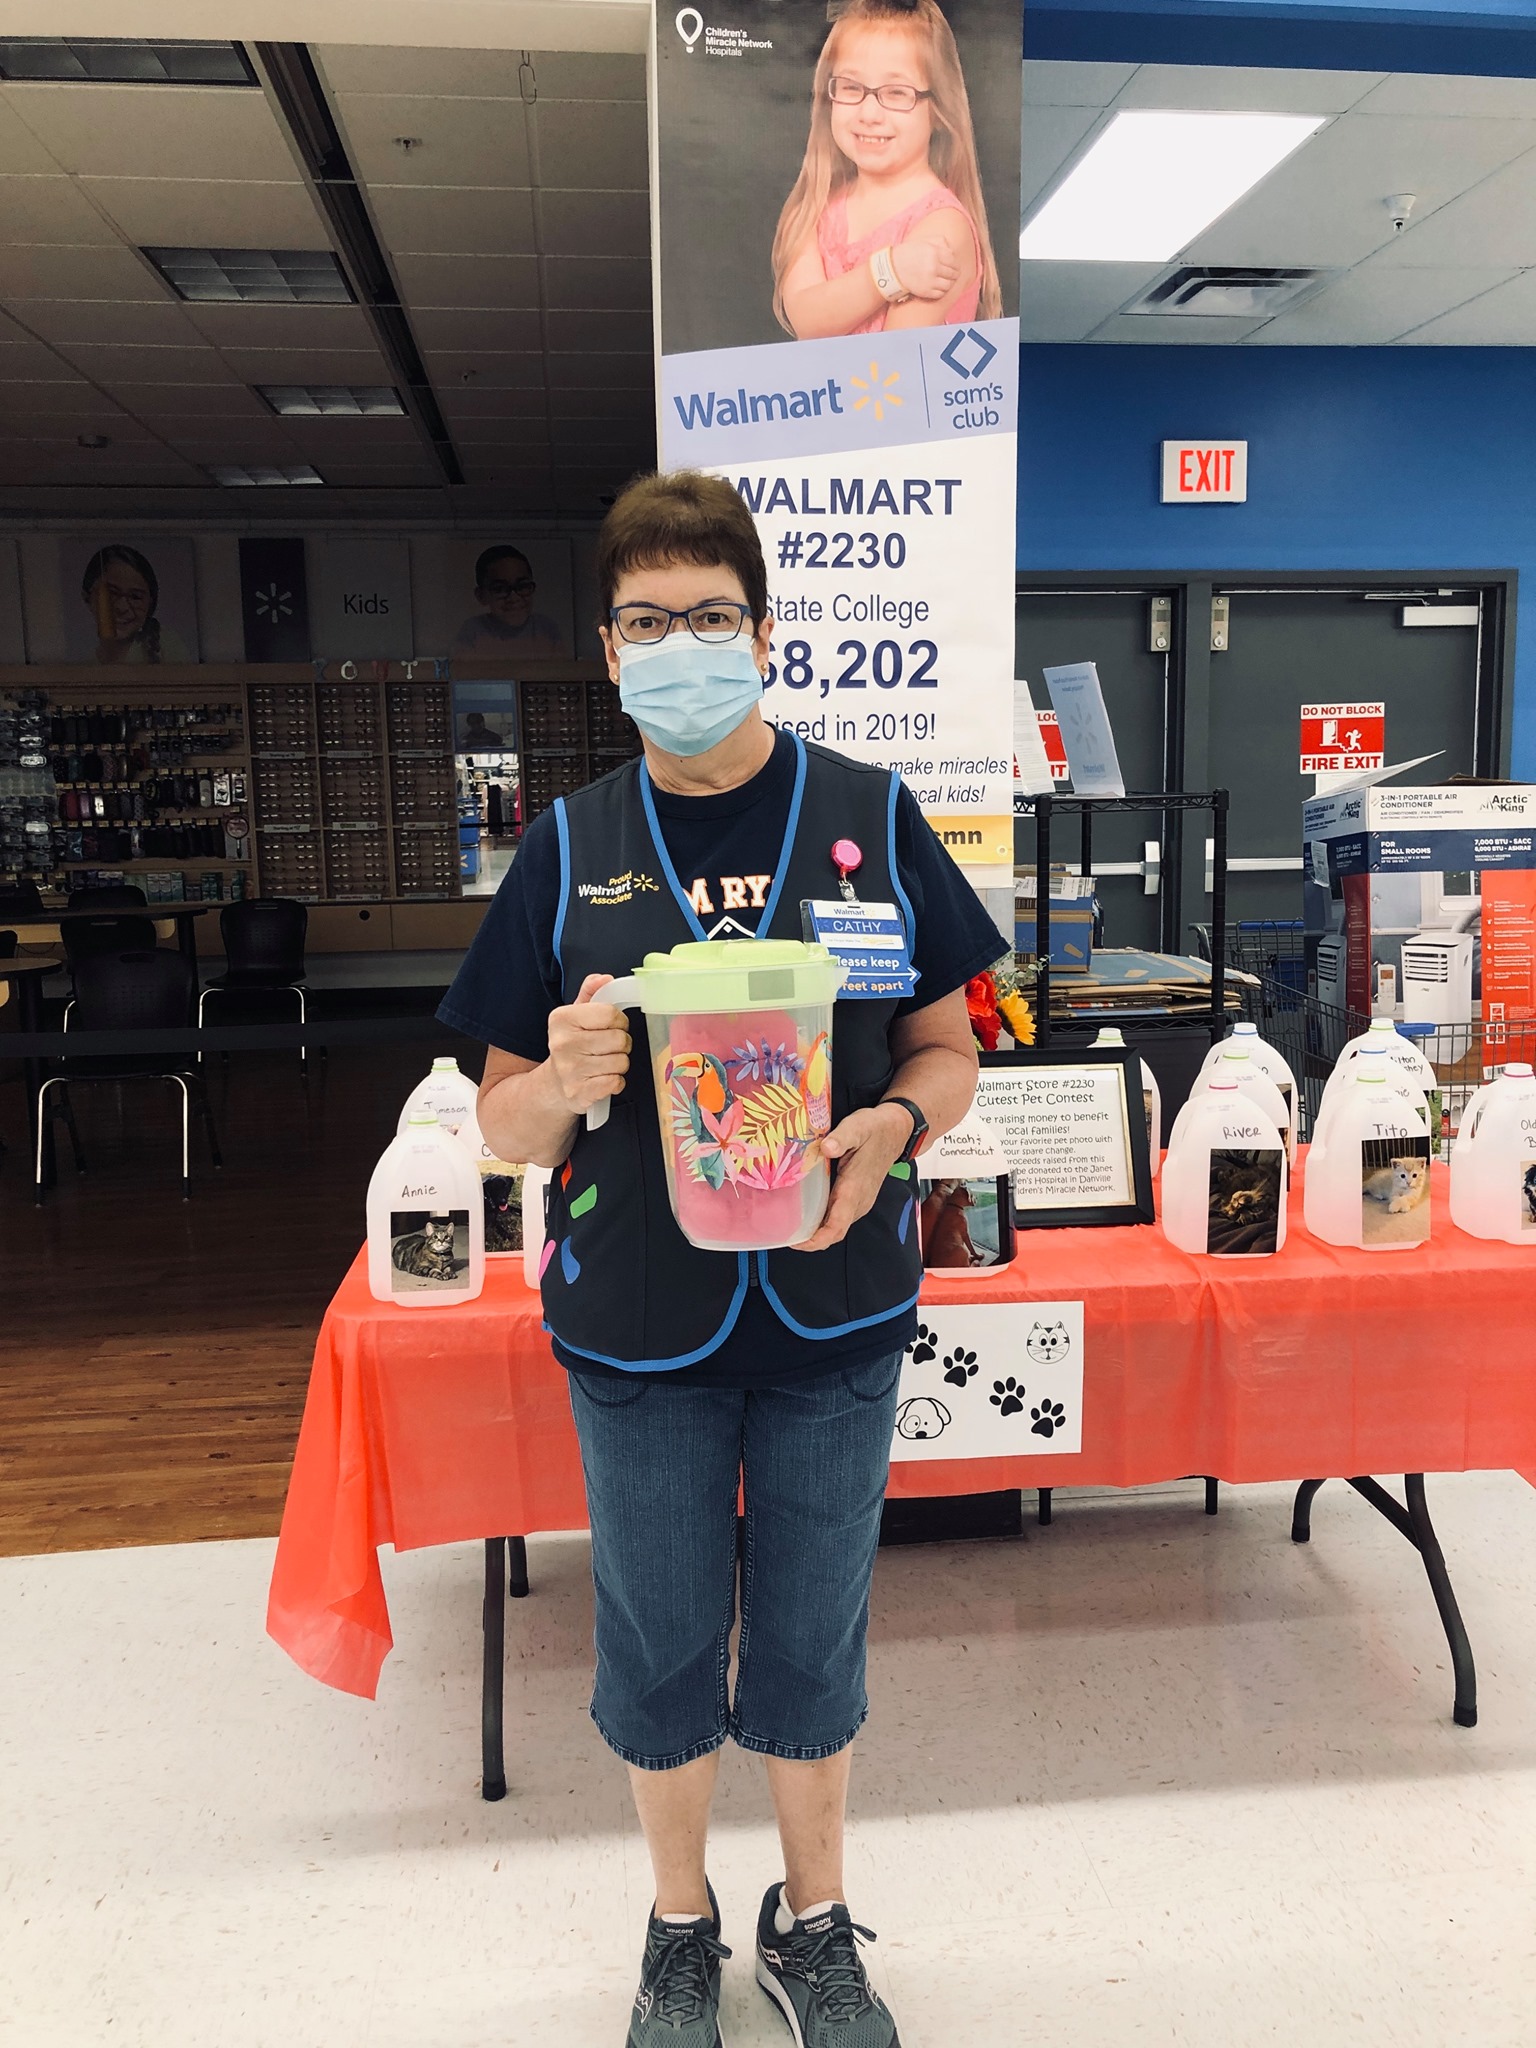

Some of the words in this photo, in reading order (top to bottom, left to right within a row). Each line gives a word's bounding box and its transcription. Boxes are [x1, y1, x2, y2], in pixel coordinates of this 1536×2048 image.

[705, 27, 747, 38] Children's
[705, 36, 737, 47] Miracle
[738, 38, 773, 49] Network
[705, 46, 742, 57] Hospitals
[944, 383, 1004, 407] sam's
[673, 379, 844, 431] Walmart
[952, 407, 1000, 430] club
[1179, 450, 1235, 492] EXIT
[777, 530, 907, 570] #2230
[343, 593, 390, 615] Kids
[832, 593, 930, 629] College
[1035, 712, 1058, 722] LOC
[1302, 707, 1318, 716] DO
[1321, 706, 1343, 715] NOT
[1346, 705, 1382, 714] BLOCK
[773, 713, 826, 741] ised
[836, 714, 857, 741] in
[865, 713, 936, 741] 2019!
[889, 757, 933, 775] make
[938, 756, 1008, 775] miracles
[1302, 757, 1339, 771] FIRE
[1343, 756, 1381, 769] EXIT
[911, 785, 943, 803] ocal
[946, 785, 986, 803] kids!
[1492, 794, 1528, 804] Arctic
[1500, 804, 1524, 813] King
[1513, 837, 1532, 845] SACC
[608, 869, 633, 887] Proud
[578, 879, 632, 898] Walmart
[589, 892, 633, 905] Associate
[833, 908, 866, 916] Walmart
[833, 920, 881, 933] CATHY
[837, 955, 868, 967] lease
[870, 956, 900, 971] keep
[870, 981, 904, 994] apart
[976, 1080, 1023, 1093] Walmart
[1026, 1080, 1059, 1092] Store
[1062, 1080, 1095, 1089] #2230
[977, 1094, 1018, 1107] Cutest
[1021, 1094, 1043, 1106] Pet
[1046, 1093, 1094, 1105] Contest
[994, 1114, 1026, 1125] raising
[1028, 1114, 1058, 1123] money
[1060, 1113, 1071, 1121] to
[1074, 1112, 1109, 1122] benefit
[1005, 1127, 1028, 1136] local
[1031, 1126, 1070, 1135] families!
[1372, 1123, 1408, 1138] Tito
[943, 1134, 975, 1145] Micah
[1020, 1137, 1052, 1146] favorite
[1054, 1137, 1067, 1146] pet
[1069, 1136, 1094, 1146] photo
[1095, 1135, 1113, 1143] with
[940, 1146, 995, 1157] Connecticut
[1022, 1147, 1044, 1156] spare
[1045, 1146, 1076, 1155] change.
[1090, 1155, 1105, 1163] this
[1016, 1167, 1026, 1175] be
[1028, 1166, 1062, 1175] donated
[1063, 1166, 1073, 1174] to
[1090, 1165, 1113, 1173] Janet
[1034, 1176, 1068, 1185] Hospital
[1069, 1175, 1078, 1183] in
[1079, 1174, 1112, 1184] Danville
[401, 1184, 438, 1198] Annie
[1017, 1186, 1043, 1194] ldren's
[1045, 1186, 1076, 1194] Miracle
[1078, 1185, 1116, 1194] Network.
[804, 1915, 831, 1931] saucony
[666, 1927, 694, 1936] saucony
